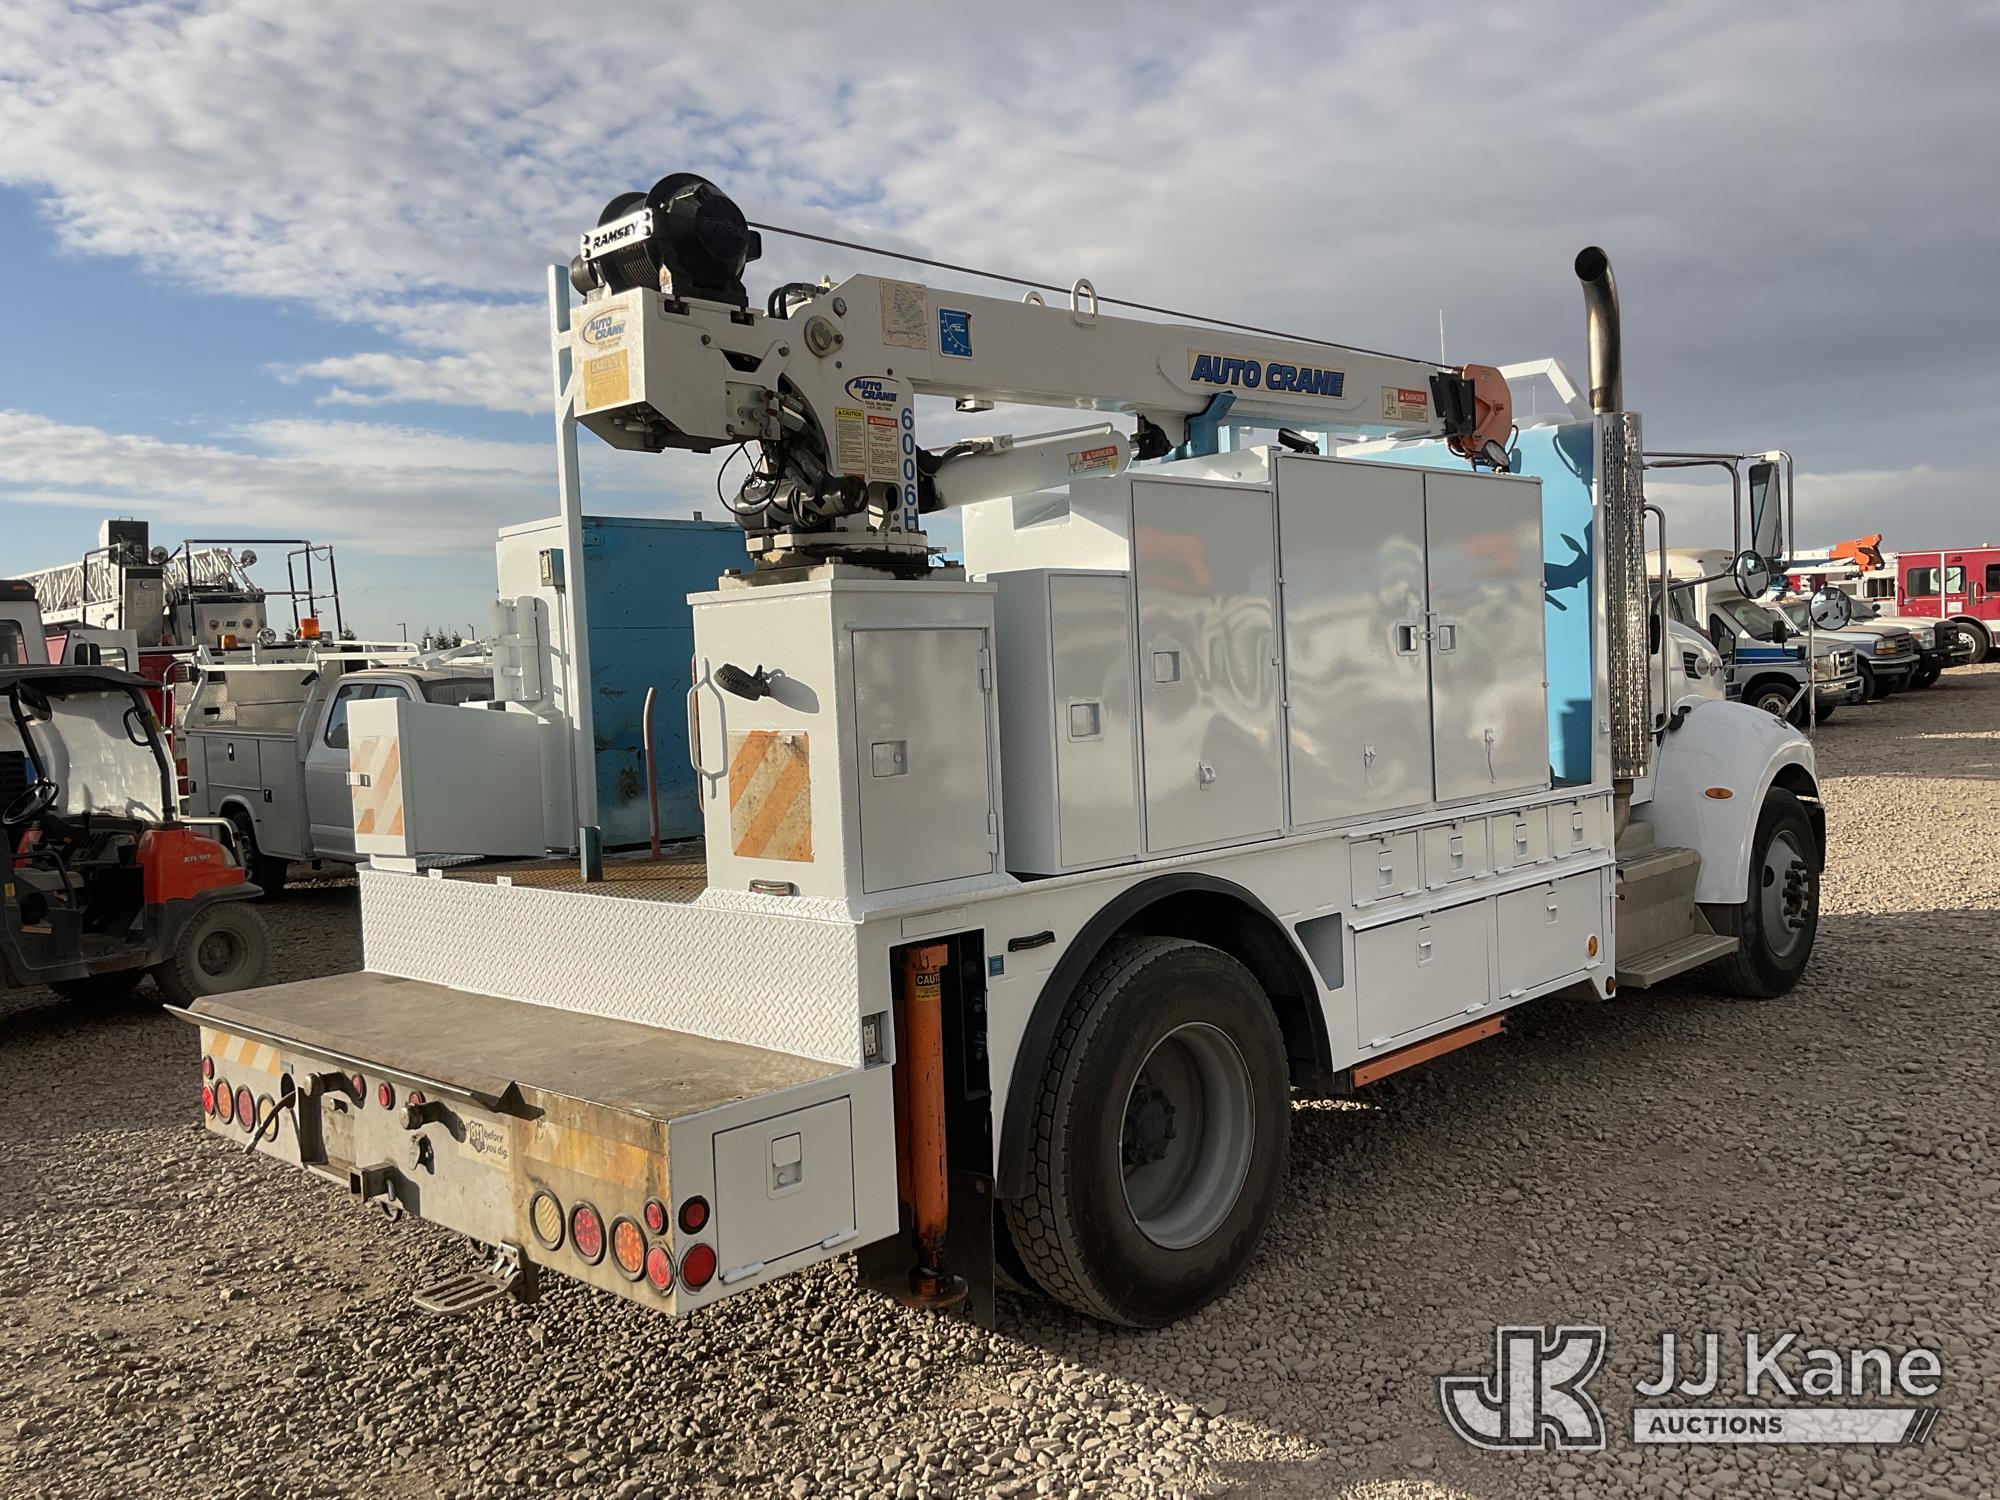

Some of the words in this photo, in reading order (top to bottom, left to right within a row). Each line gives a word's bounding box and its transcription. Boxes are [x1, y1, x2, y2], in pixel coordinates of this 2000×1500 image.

[593, 221, 639, 249] RAMSEY
[589, 316, 612, 331] AUTO
[595, 322, 625, 341] CRANE
[1191, 354, 1262, 388] AUTO
[1265, 363, 1345, 397] CRANE
[853, 380, 882, 392] AUTO
[861, 390, 897, 402] CRANE
[1404, 392, 1425, 403] DANGER
[842, 409, 862, 417] CAUTION
[874, 418, 897, 427] DANGER
[1091, 448, 1114, 459] DANGER
[901, 407, 919, 530] 6006H
[484, 1128, 503, 1142] before
[482, 1144, 497, 1154] you
